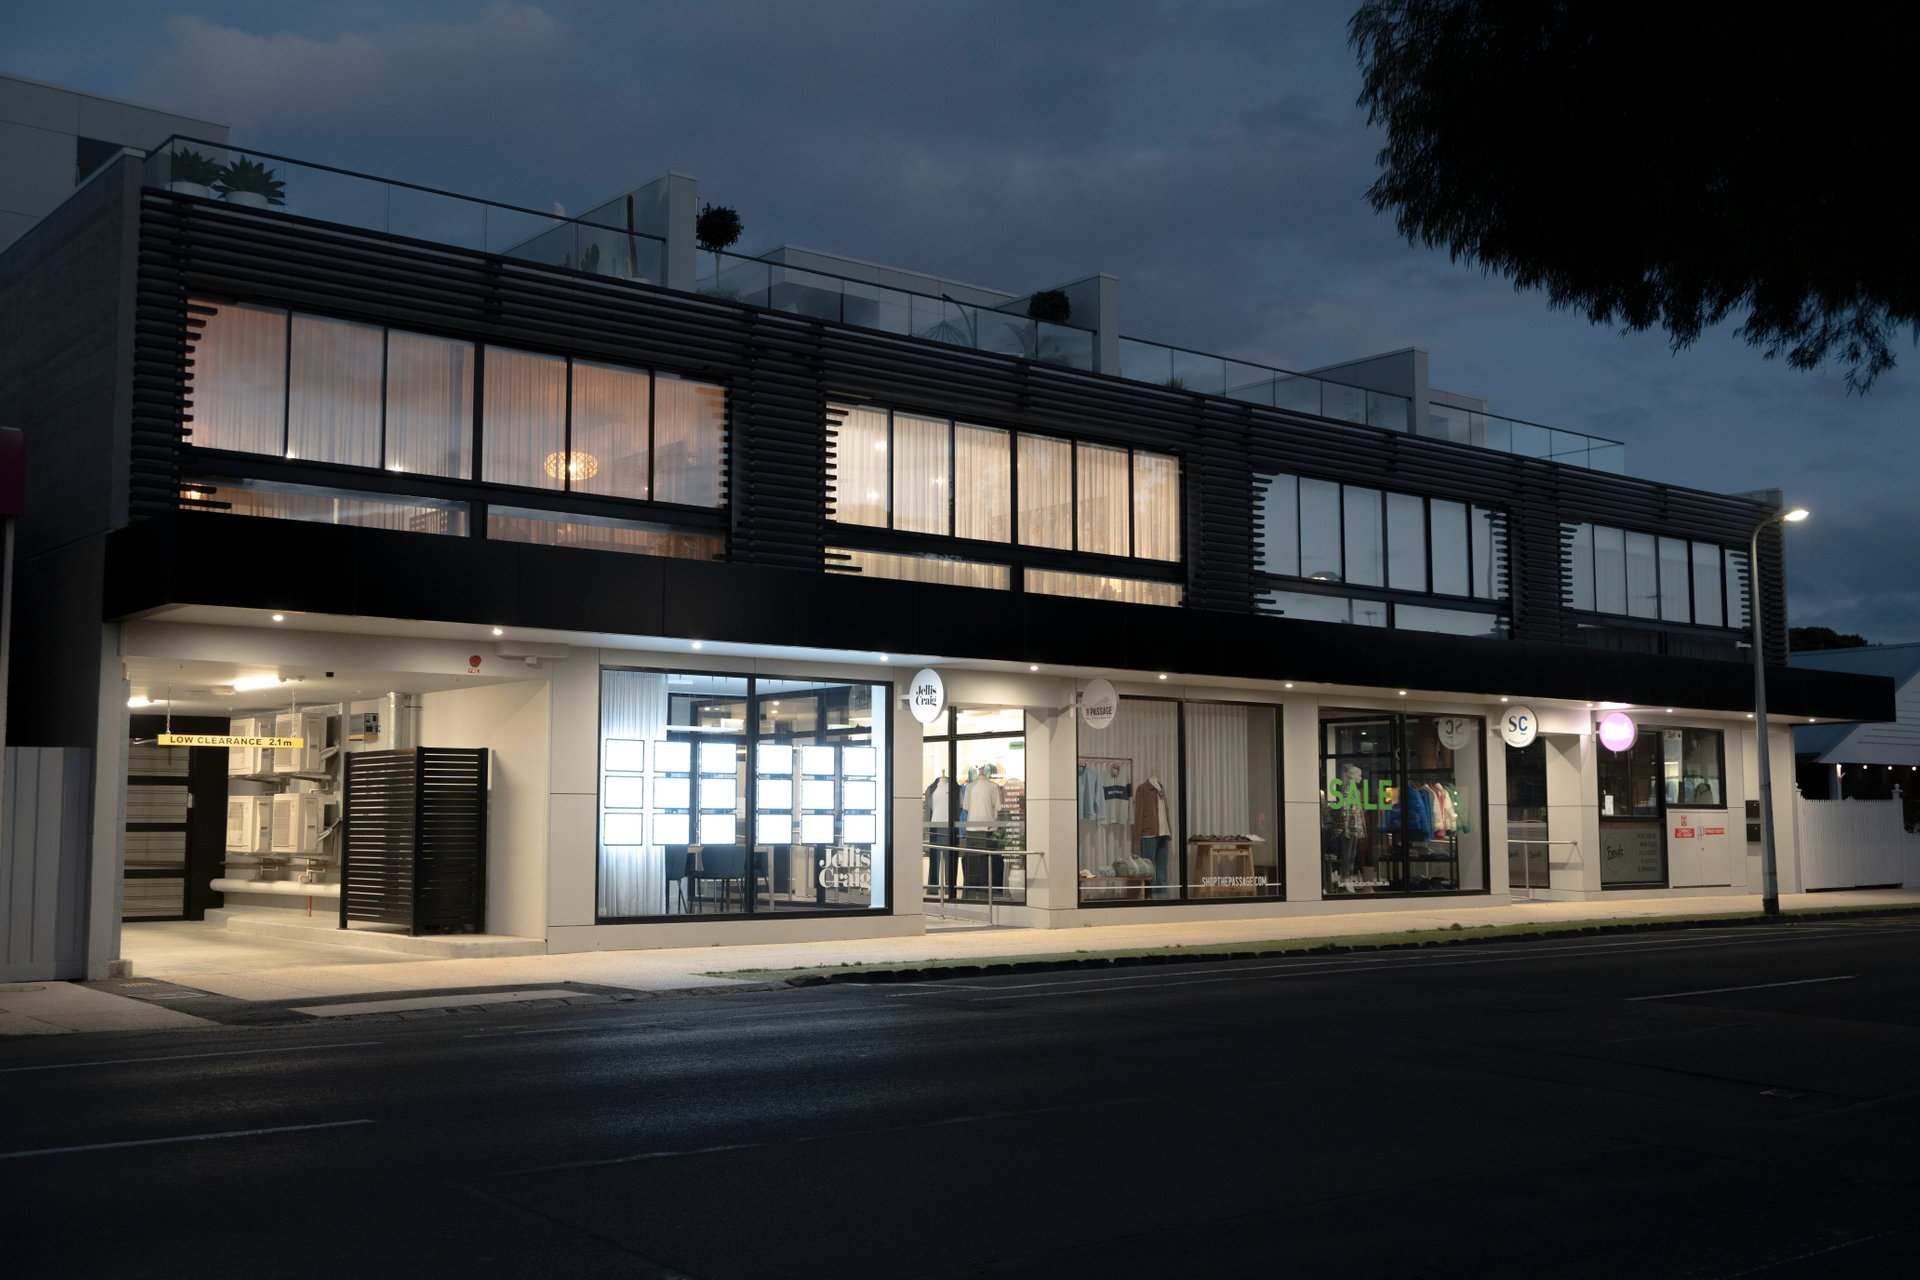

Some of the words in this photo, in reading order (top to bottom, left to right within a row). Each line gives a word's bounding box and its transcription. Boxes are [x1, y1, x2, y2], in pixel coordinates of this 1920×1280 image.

[916, 684, 937, 695] Jellis
[916, 695, 937, 707] Craig
[1090, 706, 1113, 716] PASSAGE
[1508, 715, 1528, 732] SC
[170, 736, 194, 744] LOW
[198, 737, 262, 746] CLEARANCE
[1328, 778, 1393, 811] SALE
[819, 847, 871, 868] Jellis
[819, 868, 871, 895] Craig
